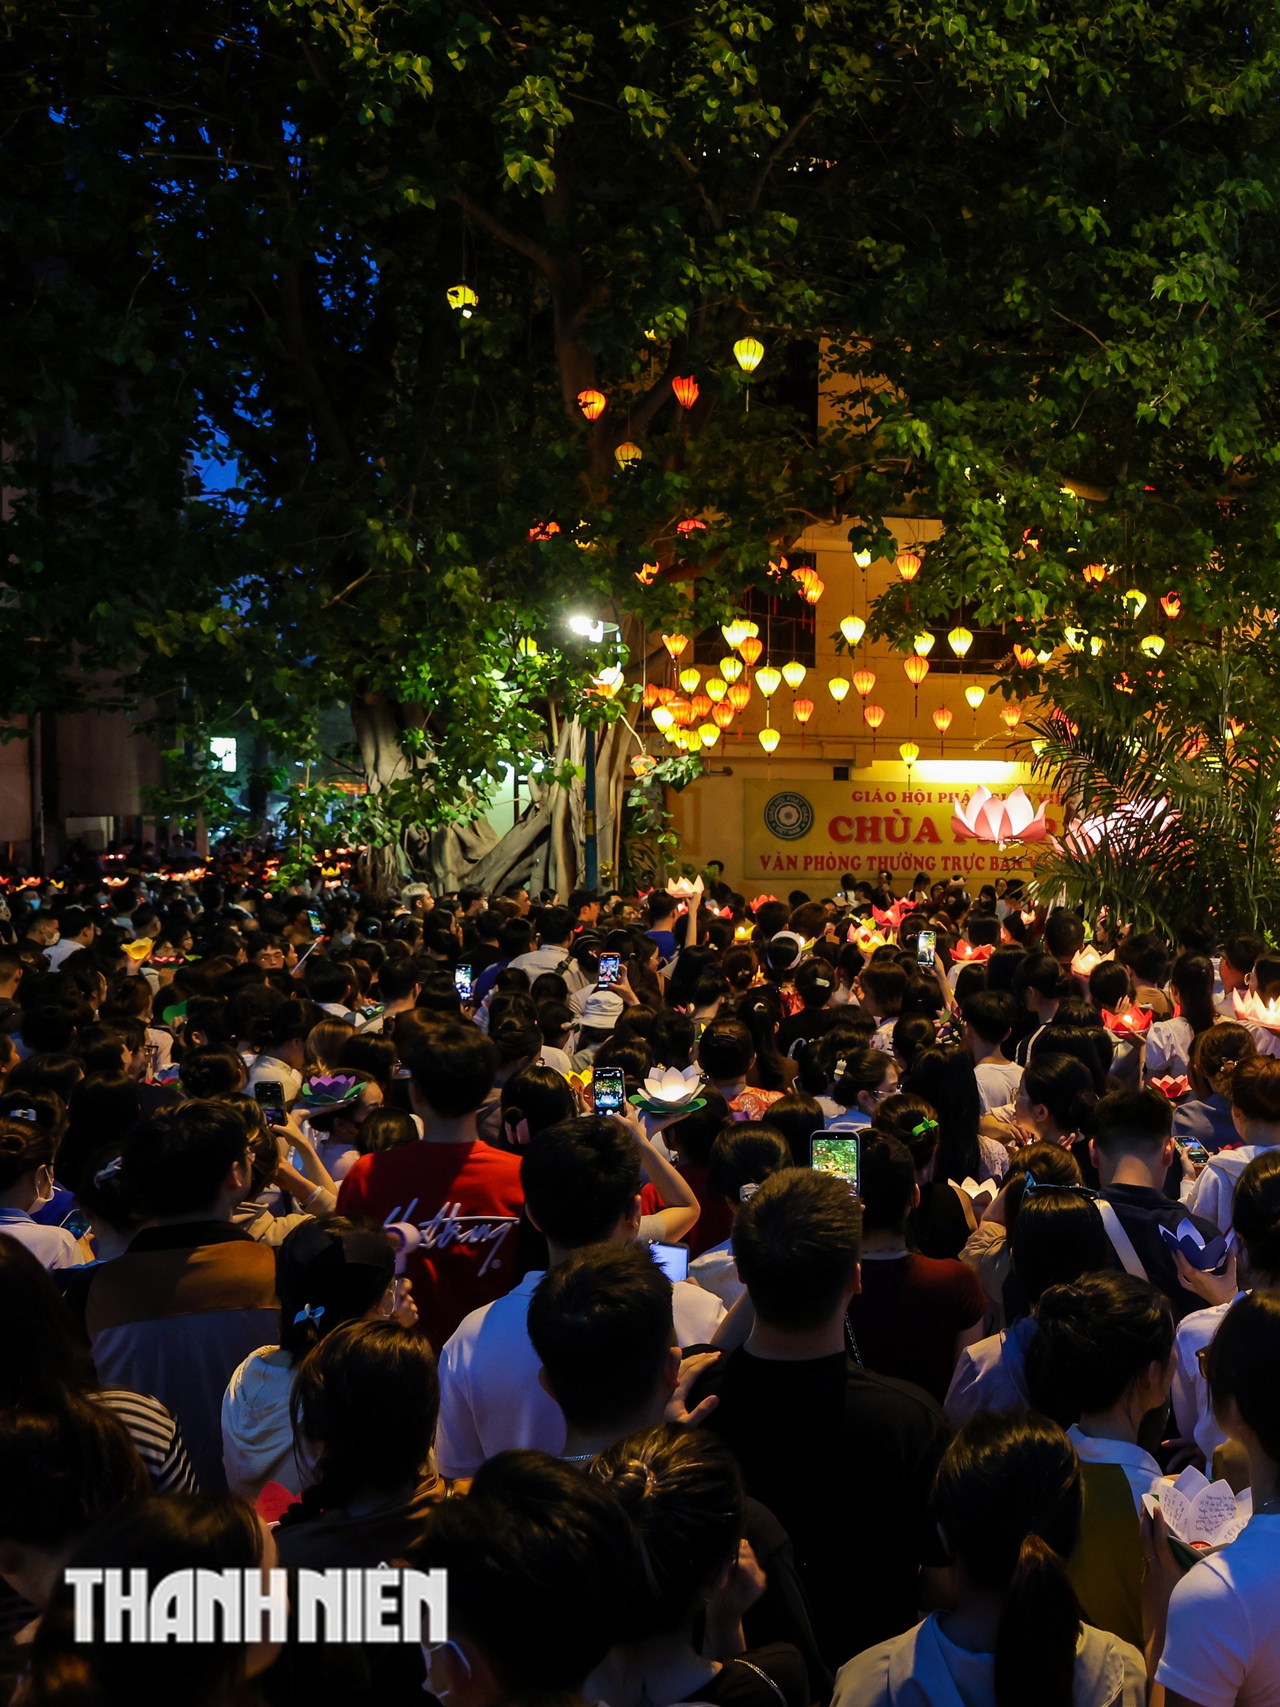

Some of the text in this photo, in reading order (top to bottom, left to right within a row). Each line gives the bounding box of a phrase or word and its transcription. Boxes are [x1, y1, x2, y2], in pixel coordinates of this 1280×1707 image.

[851, 788, 897, 803] GIÁO
[901, 789, 932, 805] HỘI
[937, 790, 971, 806] PHẬ
[827, 808, 943, 844] CHÙA
[759, 851, 798, 872] VĂN
[802, 850, 862, 872] PHÒNG
[866, 851, 936, 872] THƯỜNG
[940, 852, 985, 875] TRỰC
